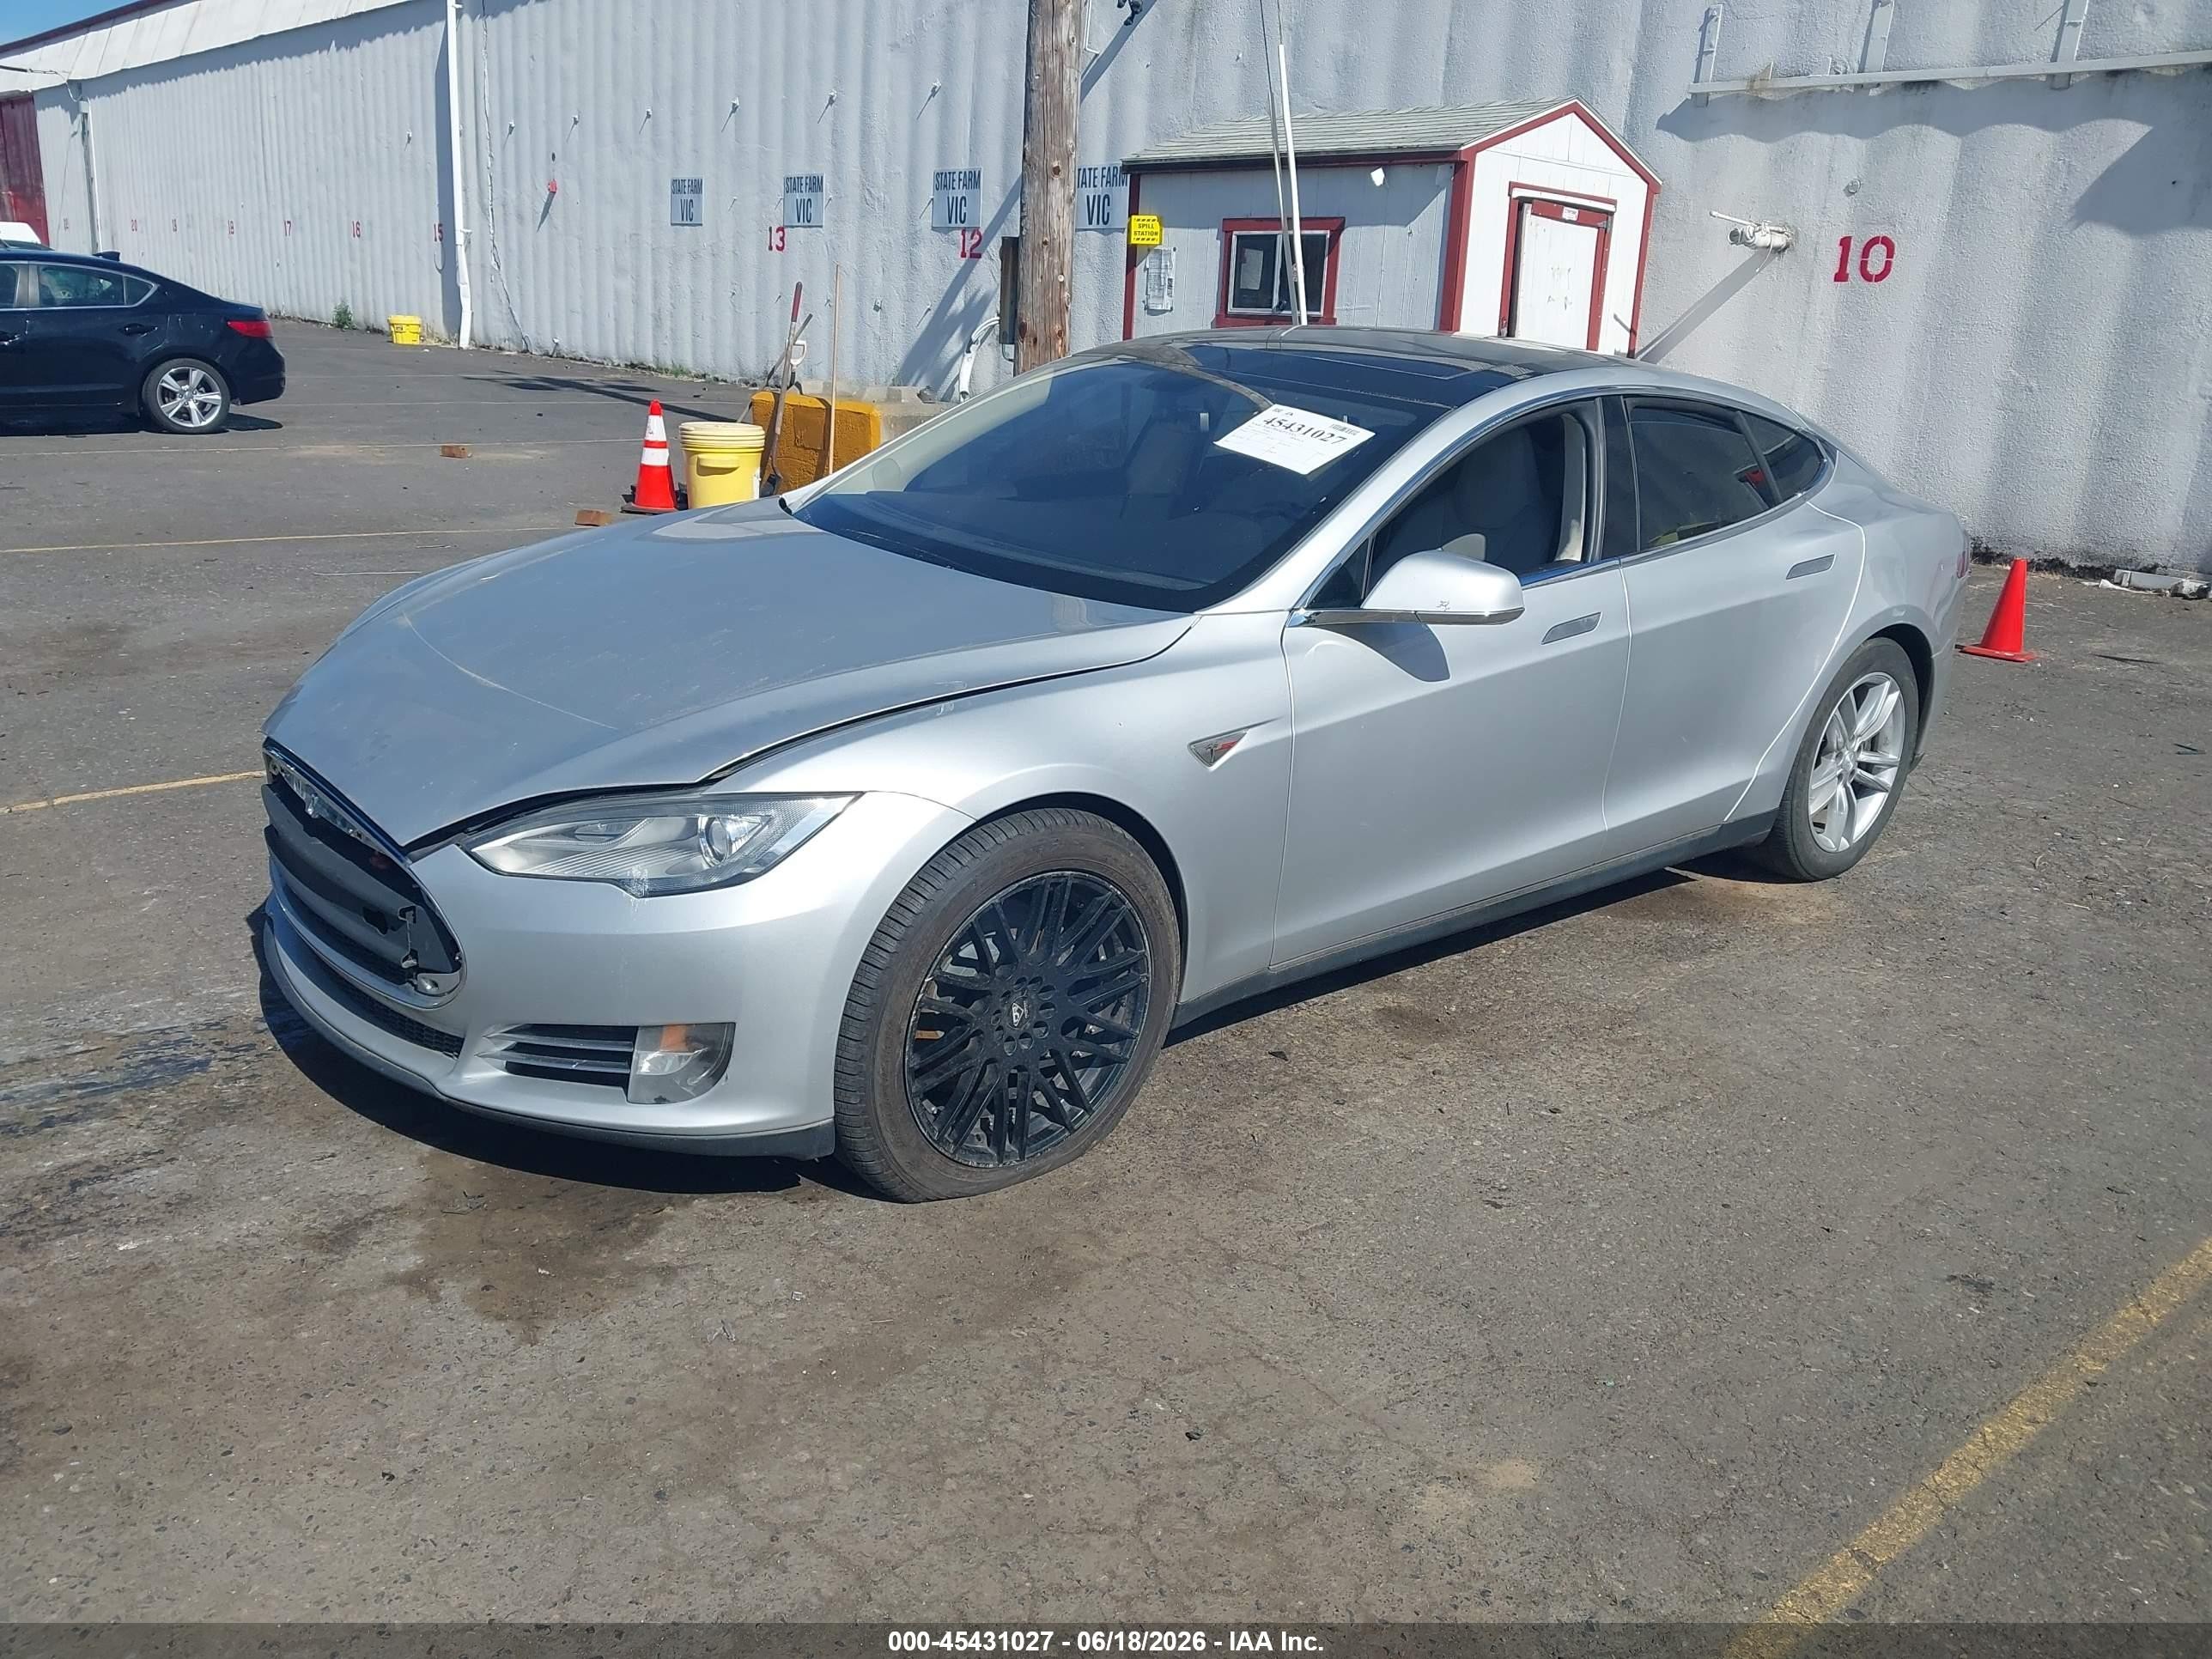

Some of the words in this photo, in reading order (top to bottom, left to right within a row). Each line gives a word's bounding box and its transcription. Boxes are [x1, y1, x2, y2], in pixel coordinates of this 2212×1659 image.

[672, 179, 687, 194] STATE
[687, 178, 702, 194] FARM
[786, 177, 804, 194] STATE
[805, 175, 823, 193] FARM
[935, 171, 957, 191] STATE
[957, 170, 981, 190] FARM
[1077, 167, 1098, 189] TATE
[1101, 166, 1128, 188] FARM
[680, 198, 694, 222] VIC
[795, 198, 812, 223] VIC
[947, 196, 967, 224] VIC
[1086, 194, 1110, 225] VIC
[283, 220, 292, 236] 17
[352, 221, 361, 238] 16
[434, 223, 443, 241] 15
[769, 226, 786, 252] 13
[960, 228, 982, 258] 12
[1833, 235, 1895, 283] 10
[1263, 416, 1347, 445] 45431027
